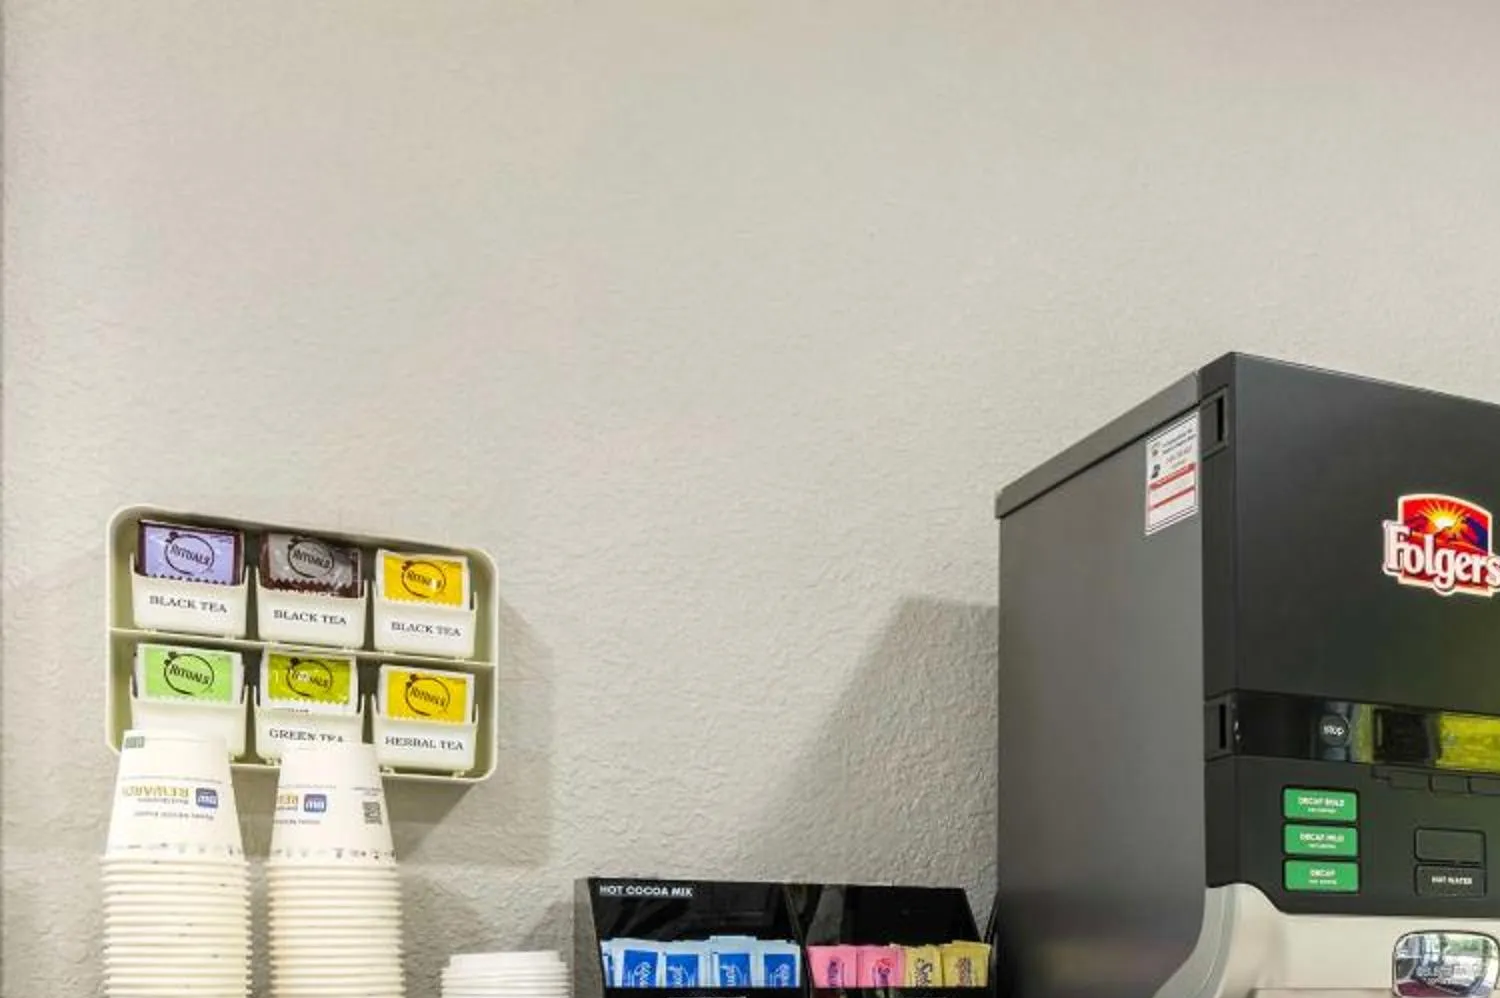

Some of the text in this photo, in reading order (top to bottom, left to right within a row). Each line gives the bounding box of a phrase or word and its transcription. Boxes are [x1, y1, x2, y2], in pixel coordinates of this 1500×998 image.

[149, 595, 228, 615] BLACK TEA
[273, 609, 348, 626] BLACK TEA
[391, 620, 462, 637] BLACK TEA
[268, 727, 317, 743] GREEN
[385, 736, 464, 752] HERBAL TEA
[600, 885, 693, 898] HOT COCOA MIX
